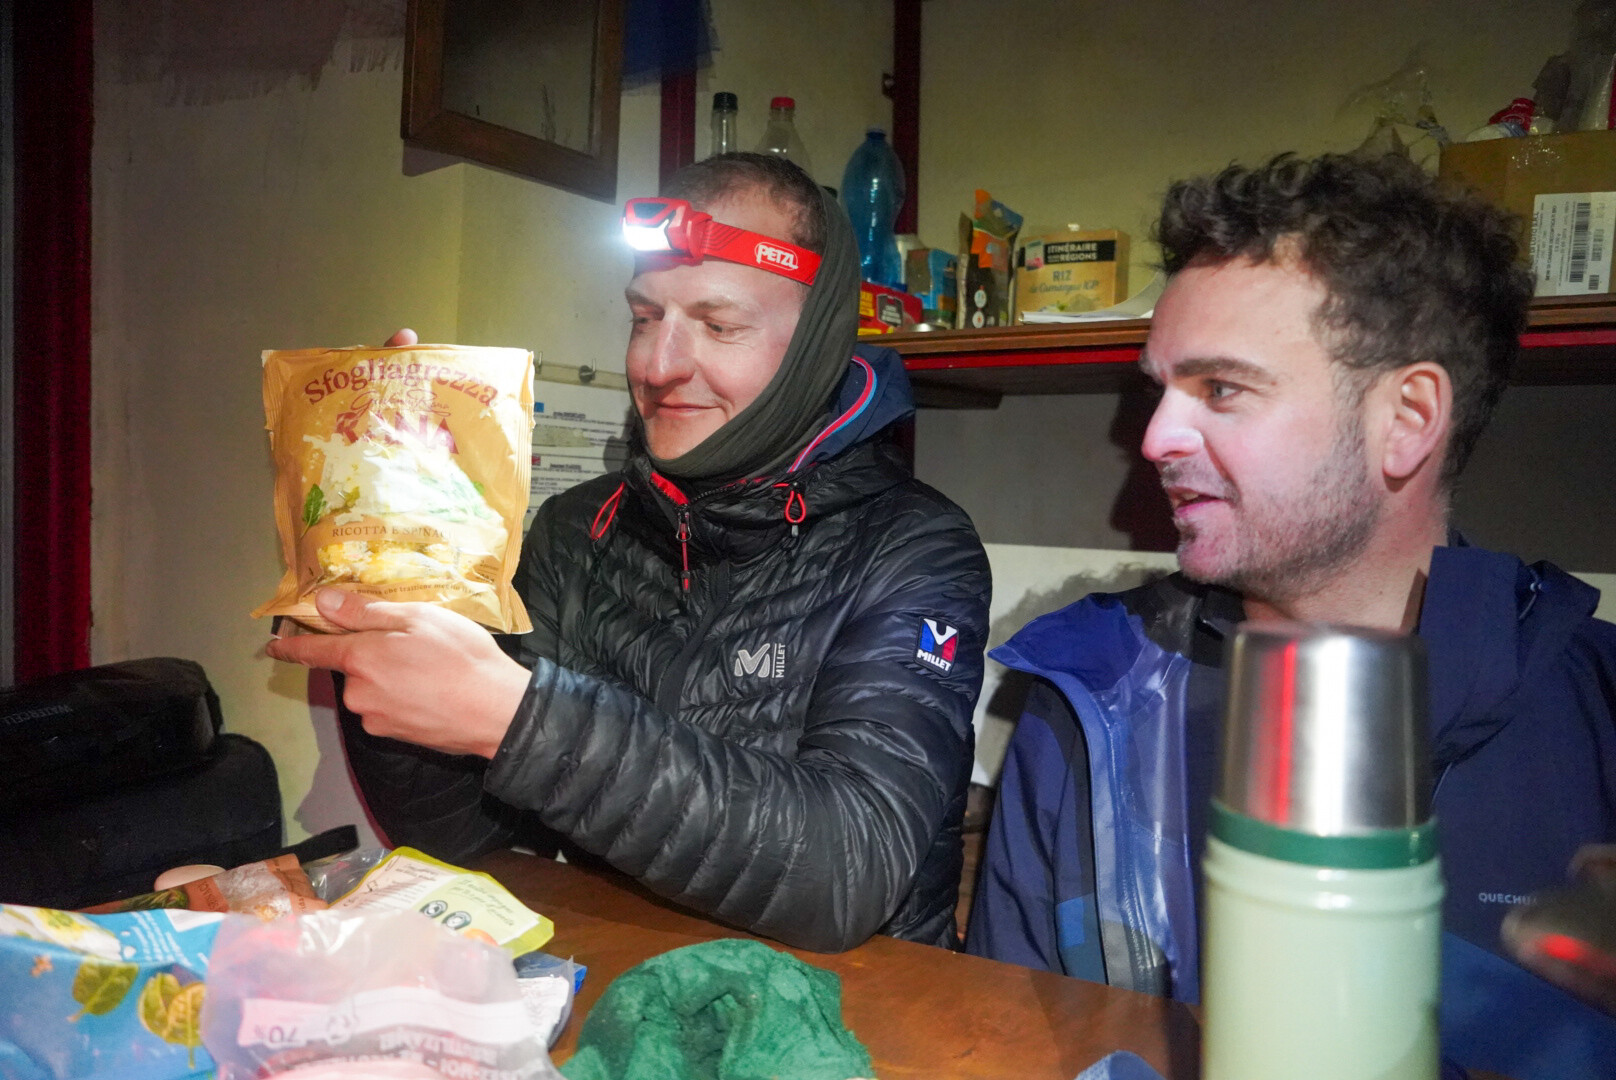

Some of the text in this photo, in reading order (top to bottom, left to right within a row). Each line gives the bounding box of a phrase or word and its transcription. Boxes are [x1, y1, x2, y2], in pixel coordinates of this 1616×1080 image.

[756, 244, 798, 270] PETZL
[1053, 270, 1072, 282] RIZ
[304, 358, 499, 407] Sfogliagrezza
[333, 525, 387, 537] RICOTTA
[776, 643, 786, 679] MILLET
[917, 650, 952, 672] MILLET
